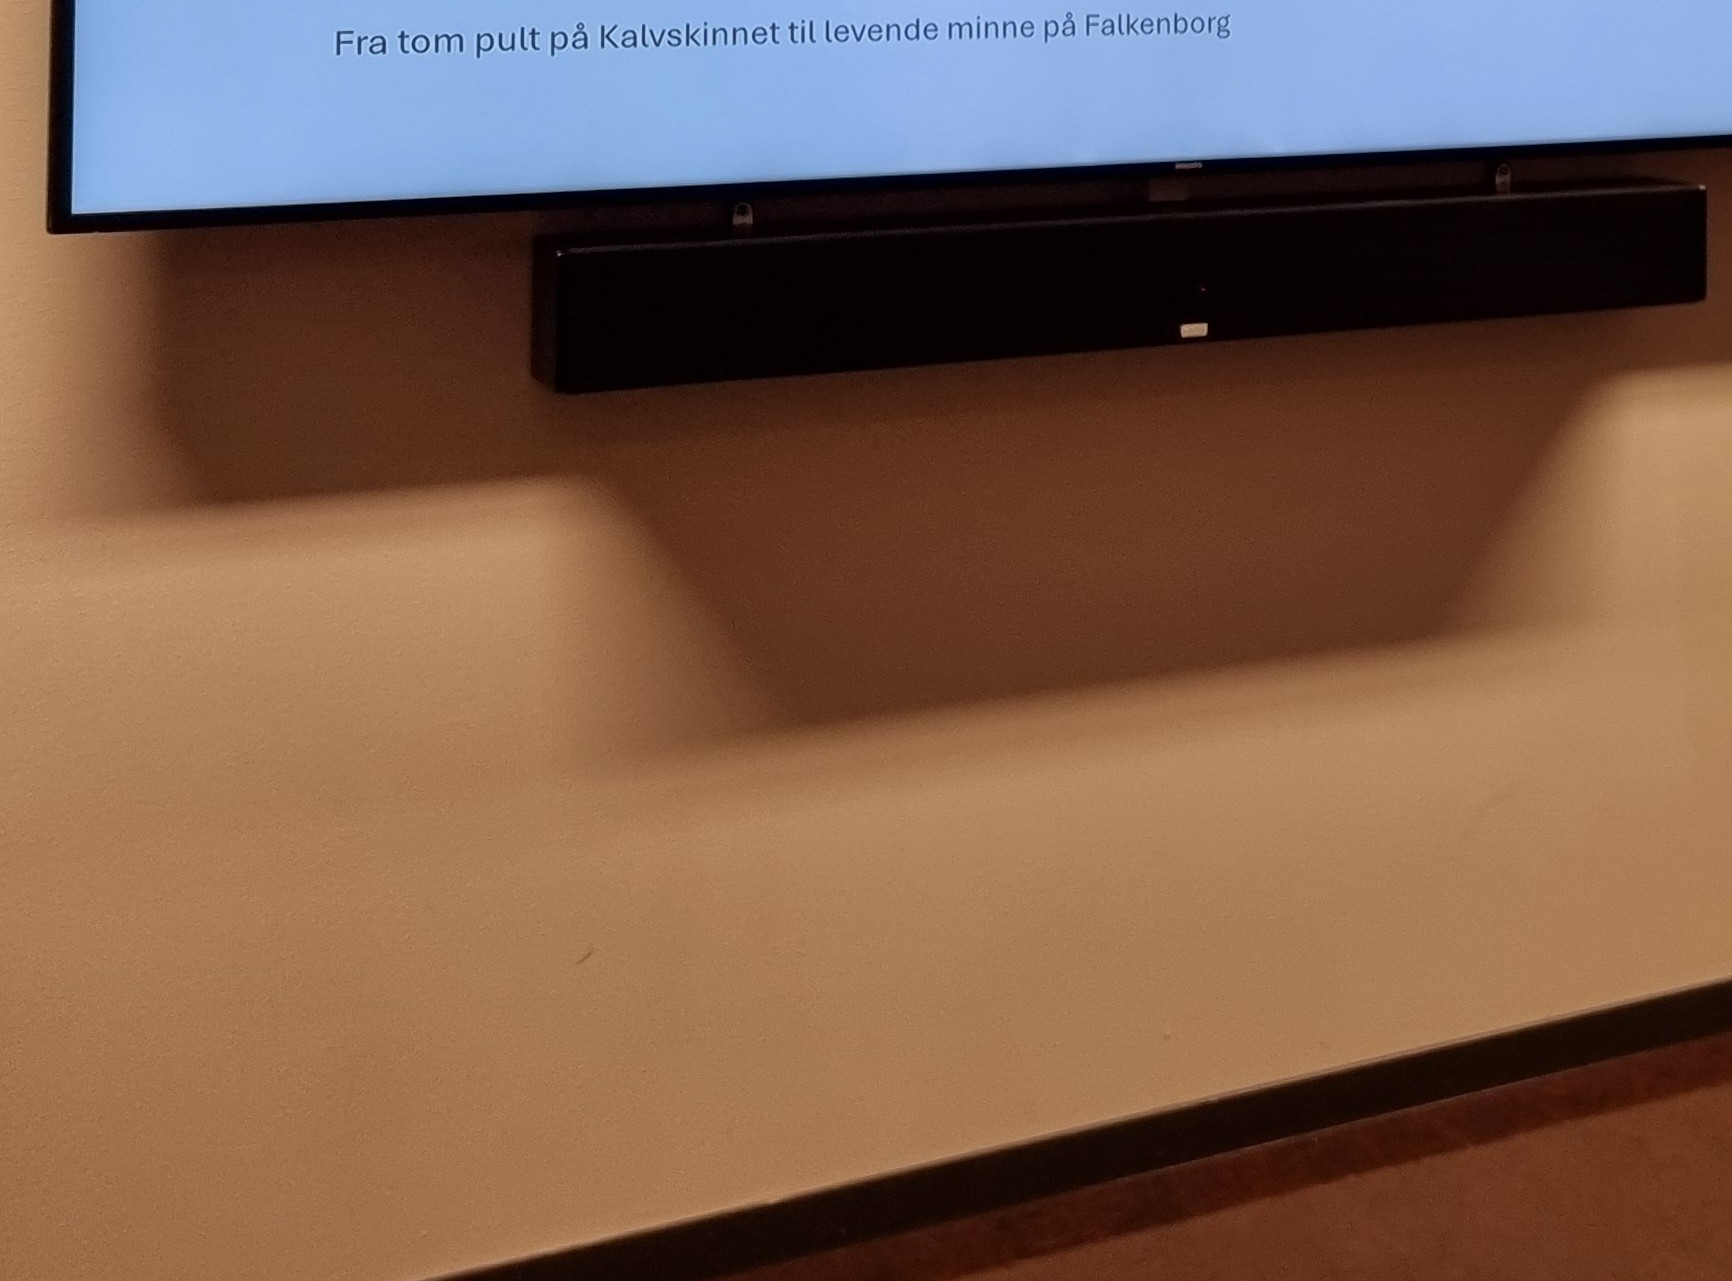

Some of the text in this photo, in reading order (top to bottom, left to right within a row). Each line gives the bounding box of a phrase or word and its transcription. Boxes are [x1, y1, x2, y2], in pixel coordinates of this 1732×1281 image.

[335, 11, 1231, 59] Fra tom pult på Kalvskinnet til levende minne på Falkenborg
